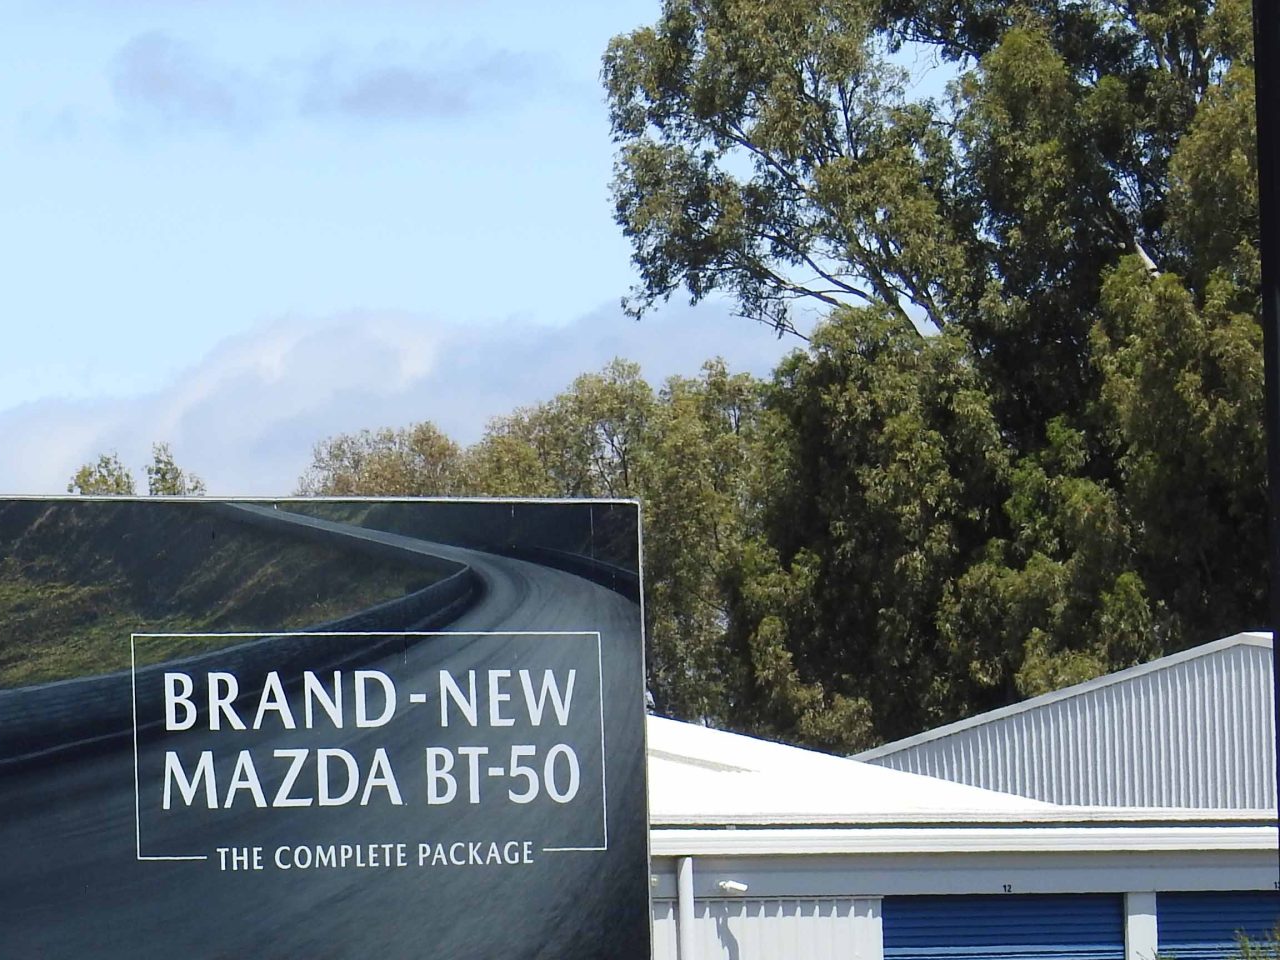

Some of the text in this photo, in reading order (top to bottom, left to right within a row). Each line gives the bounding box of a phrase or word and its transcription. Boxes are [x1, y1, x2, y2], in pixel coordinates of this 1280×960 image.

[162, 742, 581, 810] MAZDA BT-50
[216, 841, 534, 871] THE COMPLETE PACKAGE
